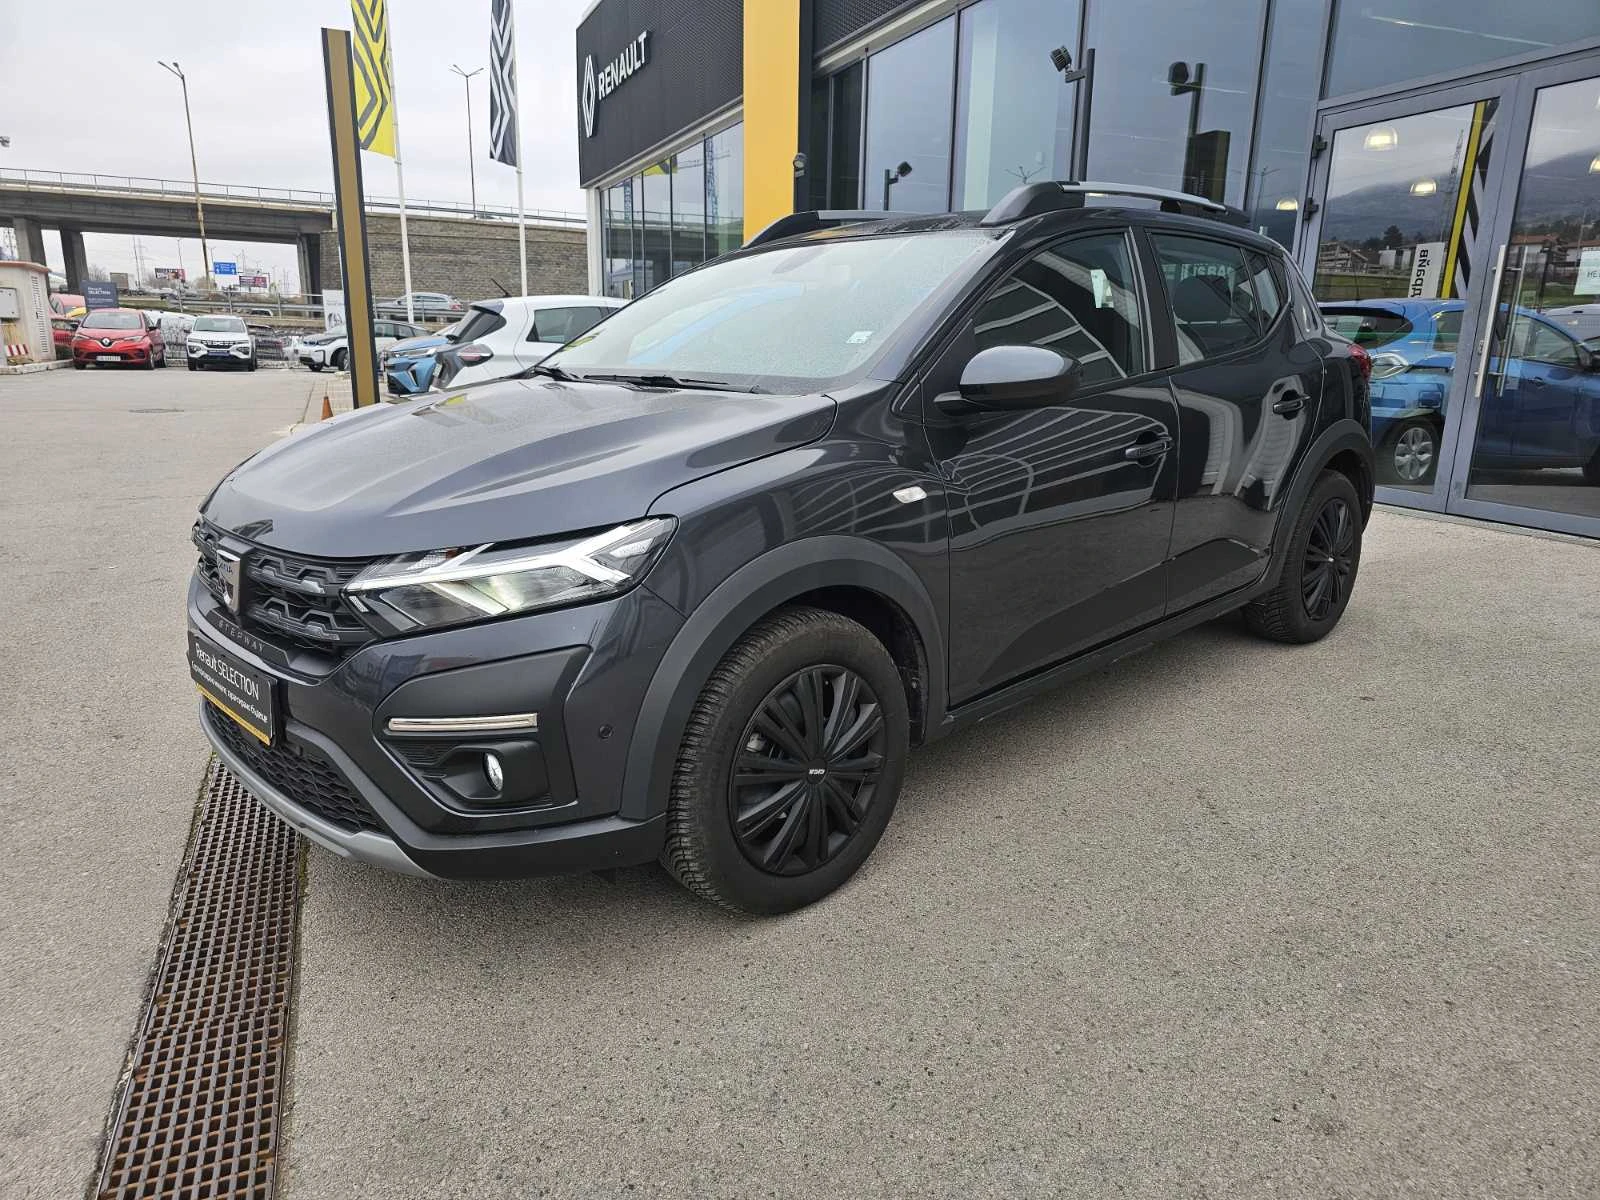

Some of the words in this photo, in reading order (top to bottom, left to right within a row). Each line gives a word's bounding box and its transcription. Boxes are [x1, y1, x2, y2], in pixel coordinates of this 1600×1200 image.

[598, 31, 647, 100] RENAULT
[218, 619, 264, 652] STEPWAY
[195, 642, 219, 673] Renault
[218, 659, 259, 701] SELECTION
